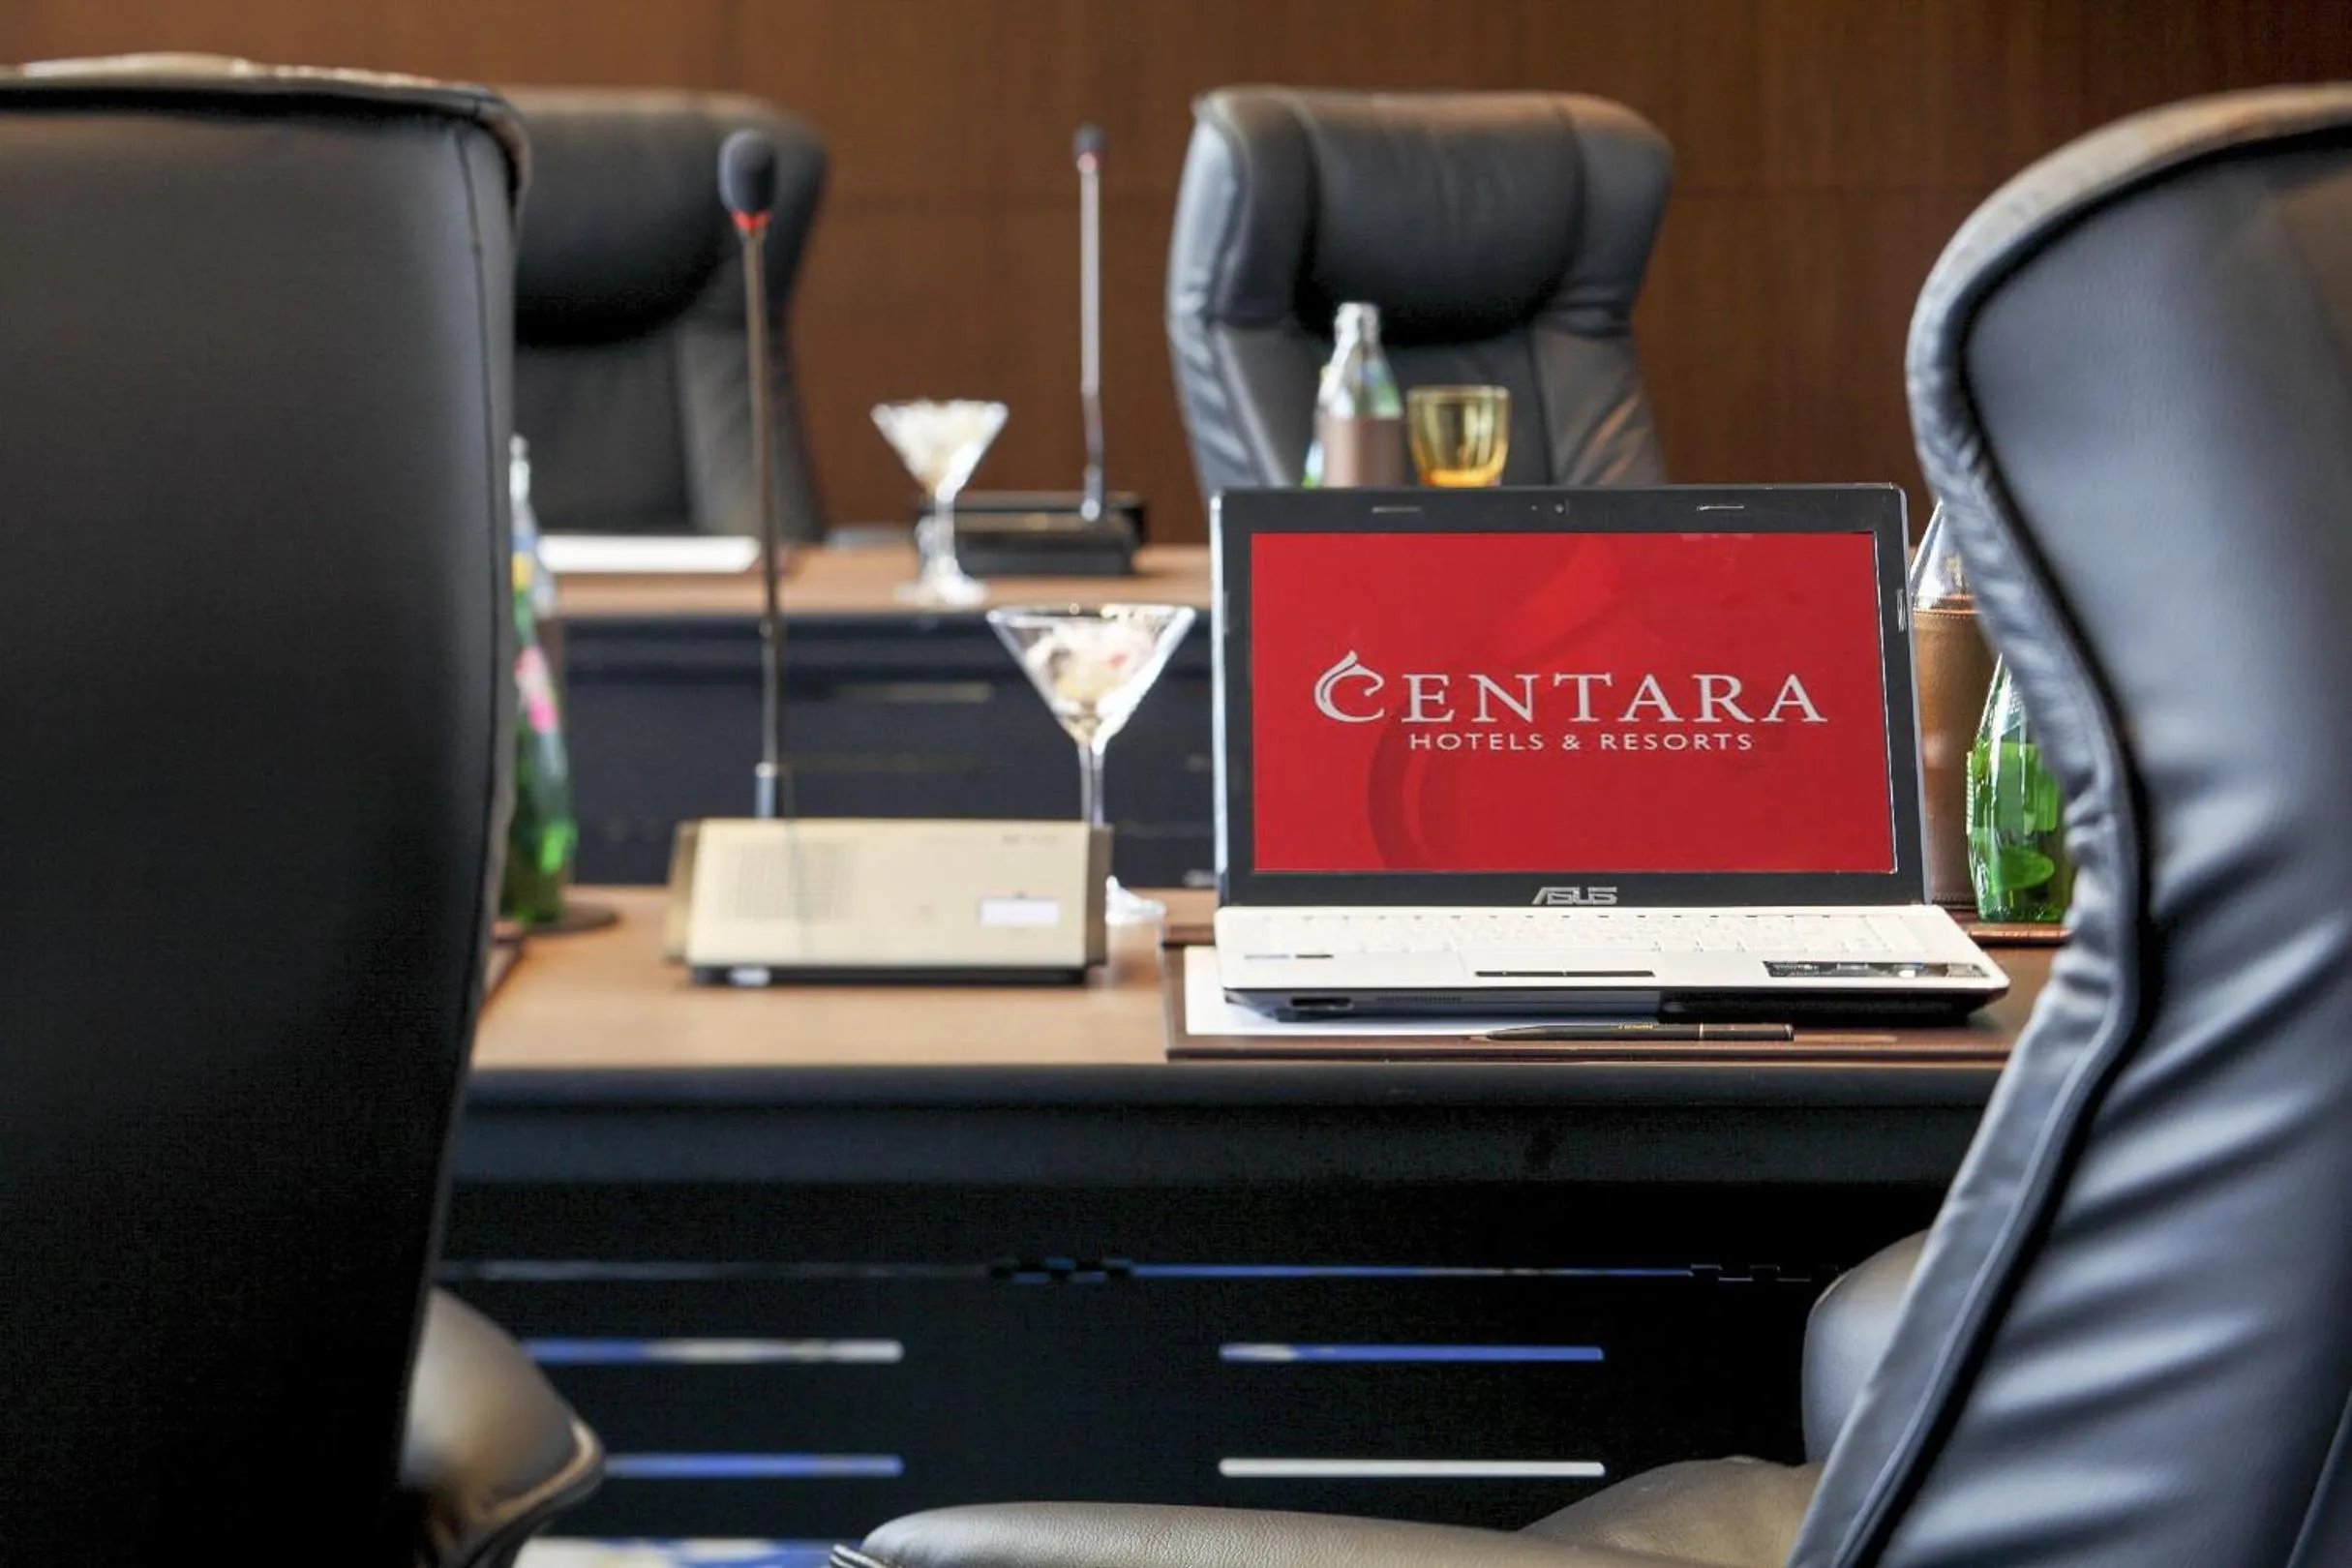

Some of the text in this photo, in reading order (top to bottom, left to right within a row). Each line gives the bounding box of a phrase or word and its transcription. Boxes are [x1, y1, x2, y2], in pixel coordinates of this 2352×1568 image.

[1313, 649, 1828, 724] CENTARA
[1409, 733, 1753, 751] HOTELS & RESORTS
[1531, 886, 1618, 906] ASUS
